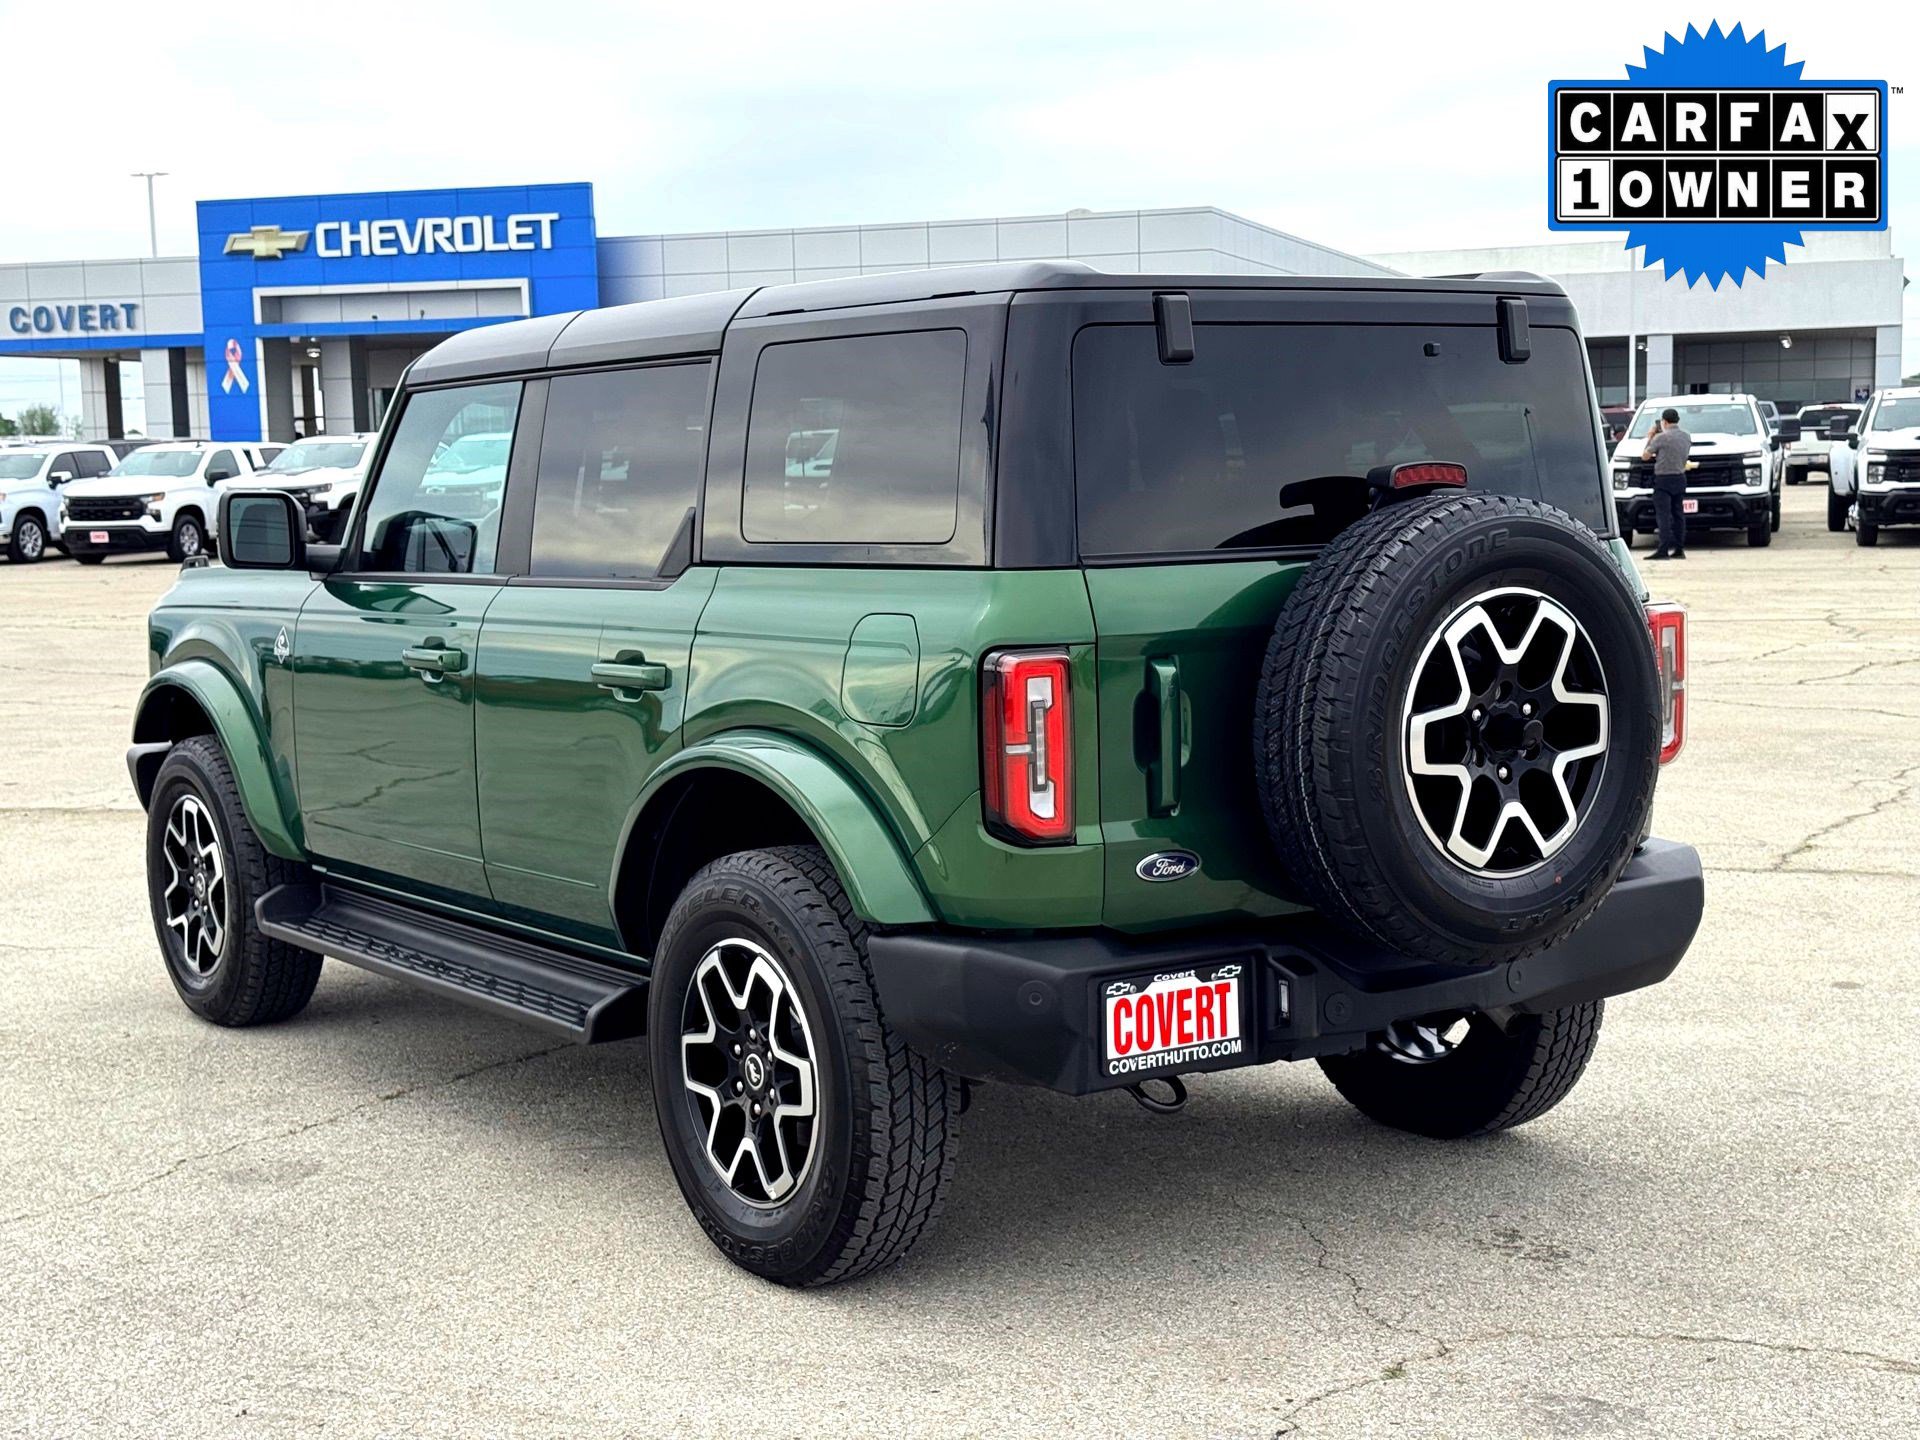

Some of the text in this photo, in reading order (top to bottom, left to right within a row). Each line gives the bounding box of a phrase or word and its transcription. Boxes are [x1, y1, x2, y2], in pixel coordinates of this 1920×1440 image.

[315, 213, 560, 258] CHEVROLET
[9, 303, 139, 334] COVERT
[1366, 528, 1510, 803] BRIDGESTONE
[1152, 858, 1186, 877] Ford
[1153, 969, 1196, 982] Covert
[1113, 981, 1231, 1056] COVERT
[1109, 1039, 1242, 1075] COVERTHUTTO.COM
